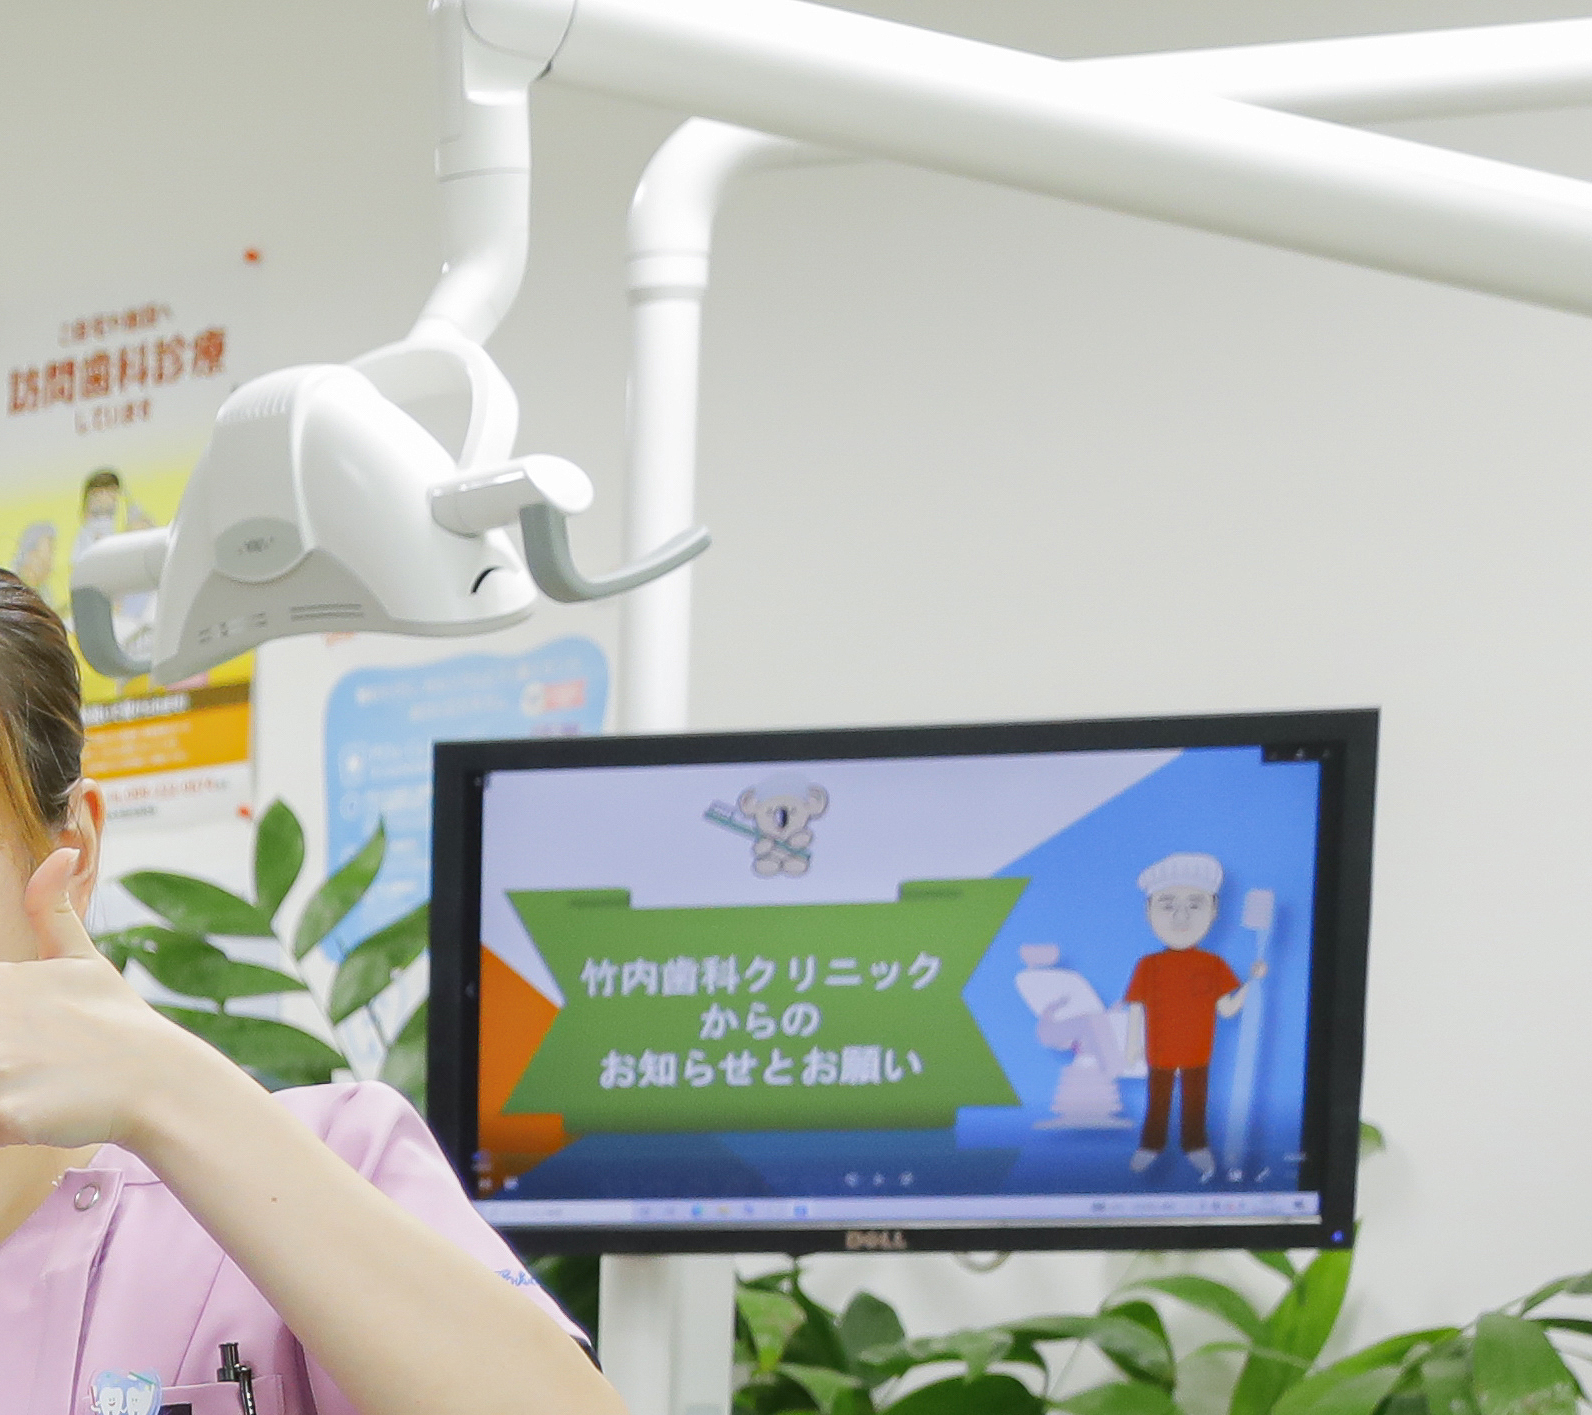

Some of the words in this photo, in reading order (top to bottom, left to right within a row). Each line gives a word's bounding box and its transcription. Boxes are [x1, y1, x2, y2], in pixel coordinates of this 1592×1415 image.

[8, 326, 227, 416] 訪問歯科診療
[580, 951, 944, 1000] 竹内歯科クリニック
[700, 1002, 821, 1041] からの
[598, 1046, 922, 1090] お知らせとお願い
